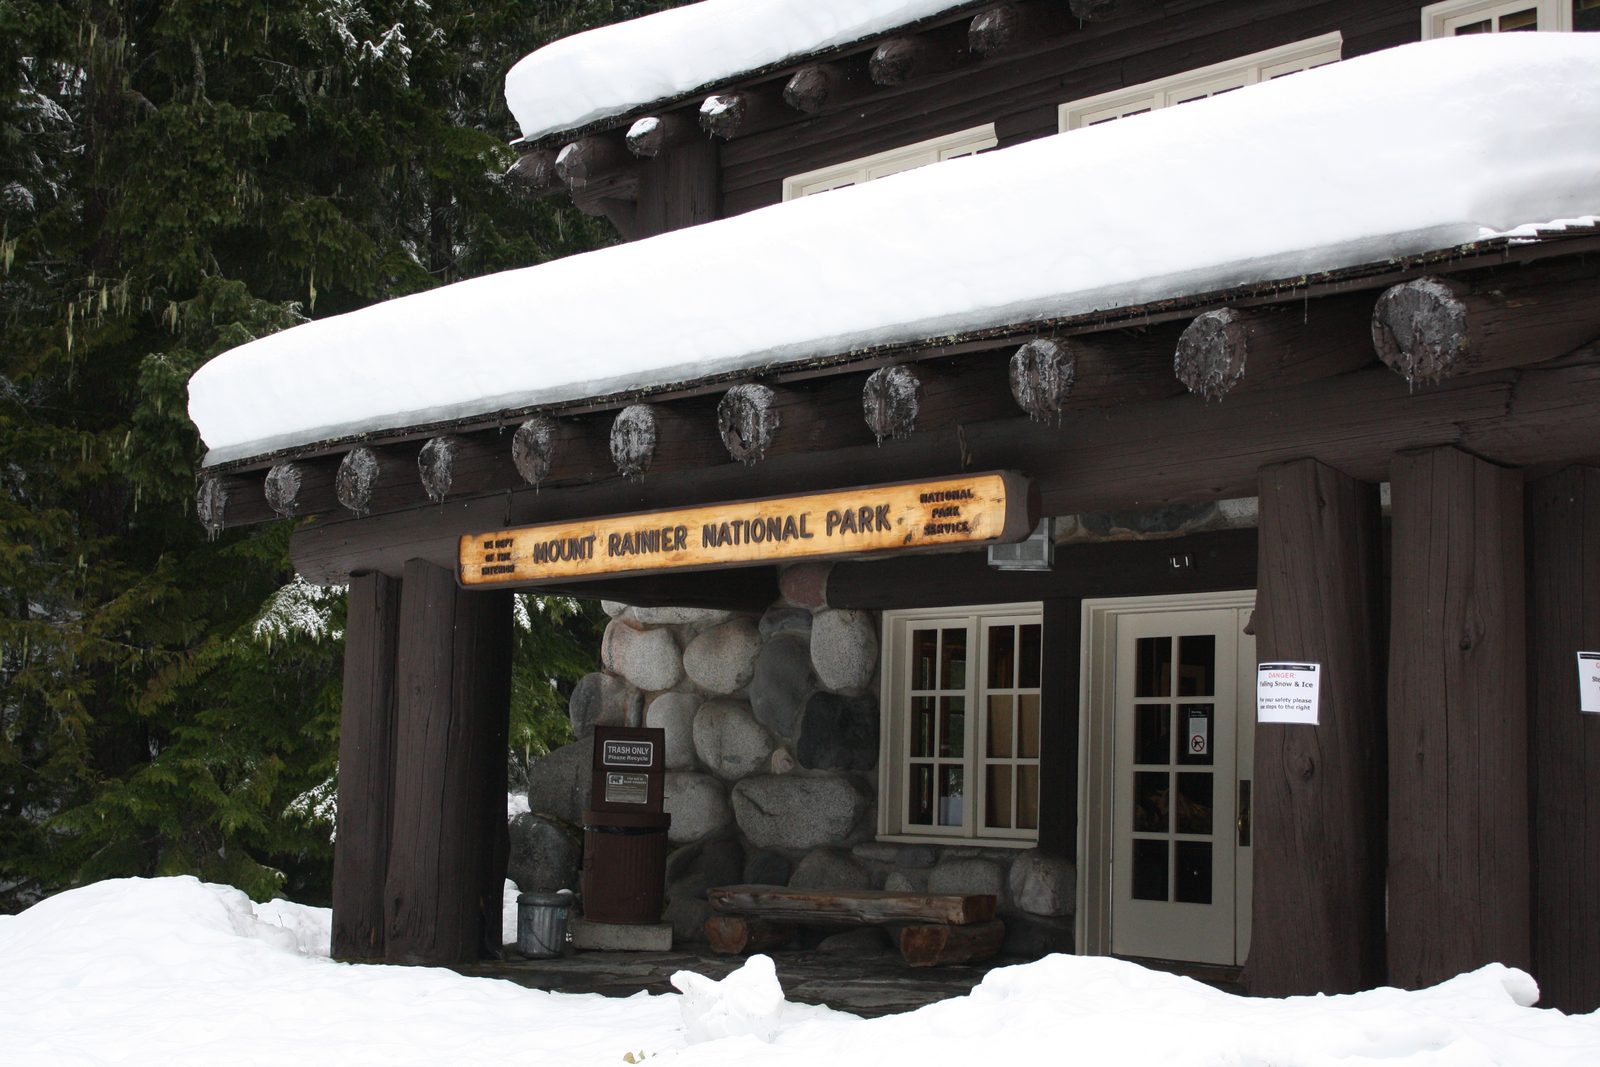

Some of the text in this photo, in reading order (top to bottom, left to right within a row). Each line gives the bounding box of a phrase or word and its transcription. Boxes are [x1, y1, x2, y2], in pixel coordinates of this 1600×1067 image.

[920, 489, 974, 504] NATIONAL
[932, 506, 960, 519] PARK
[533, 504, 892, 565] MOUNT RAINIER NATIONAL PARK
[924, 521, 970, 536] SERVICE
[497, 552, 511, 562] THE
[1274, 696, 1292, 704] safety
[607, 745, 650, 755] TRASH ONLY
